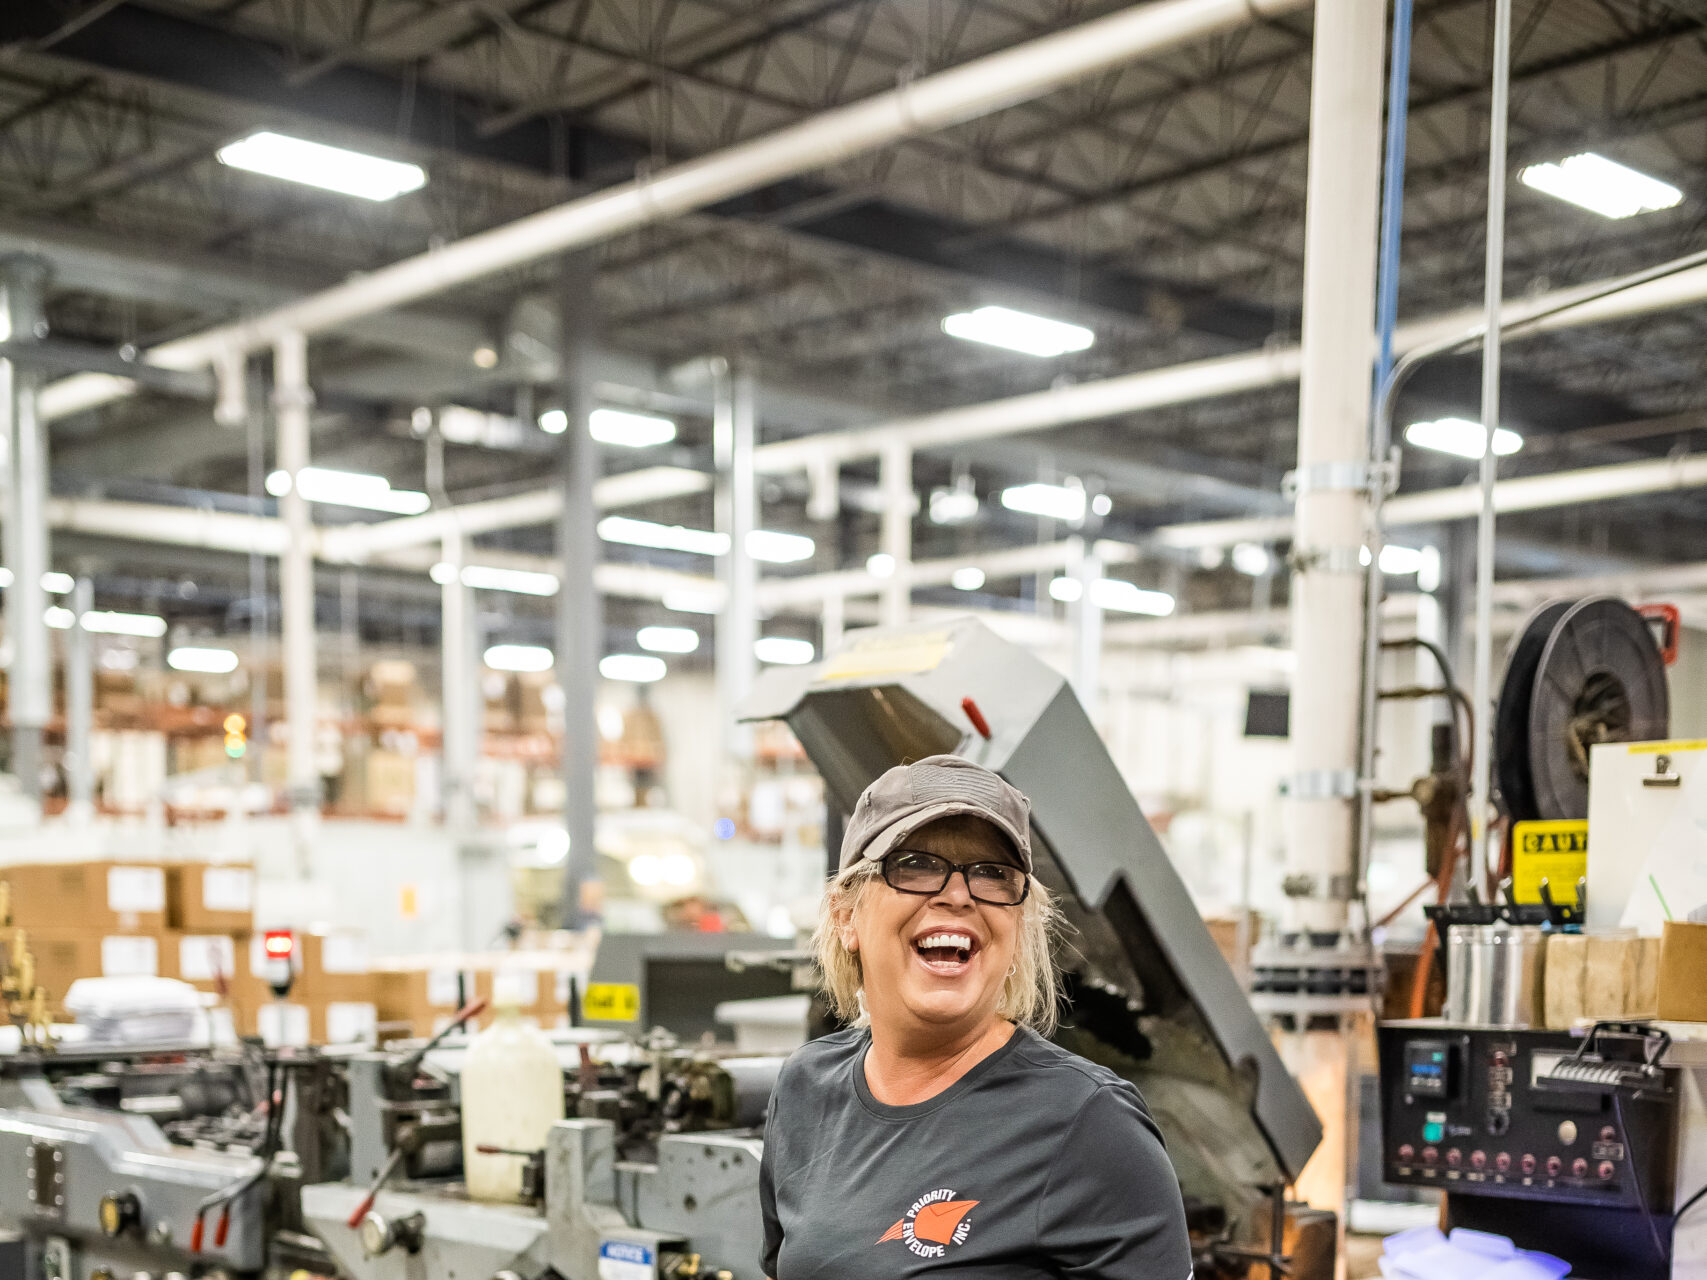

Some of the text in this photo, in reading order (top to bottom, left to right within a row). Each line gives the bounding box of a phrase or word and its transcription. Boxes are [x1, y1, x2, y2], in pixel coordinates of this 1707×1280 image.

[906, 1188, 957, 1219] PRIORITY
[902, 1218, 972, 1259] ENVELOPE INC.
